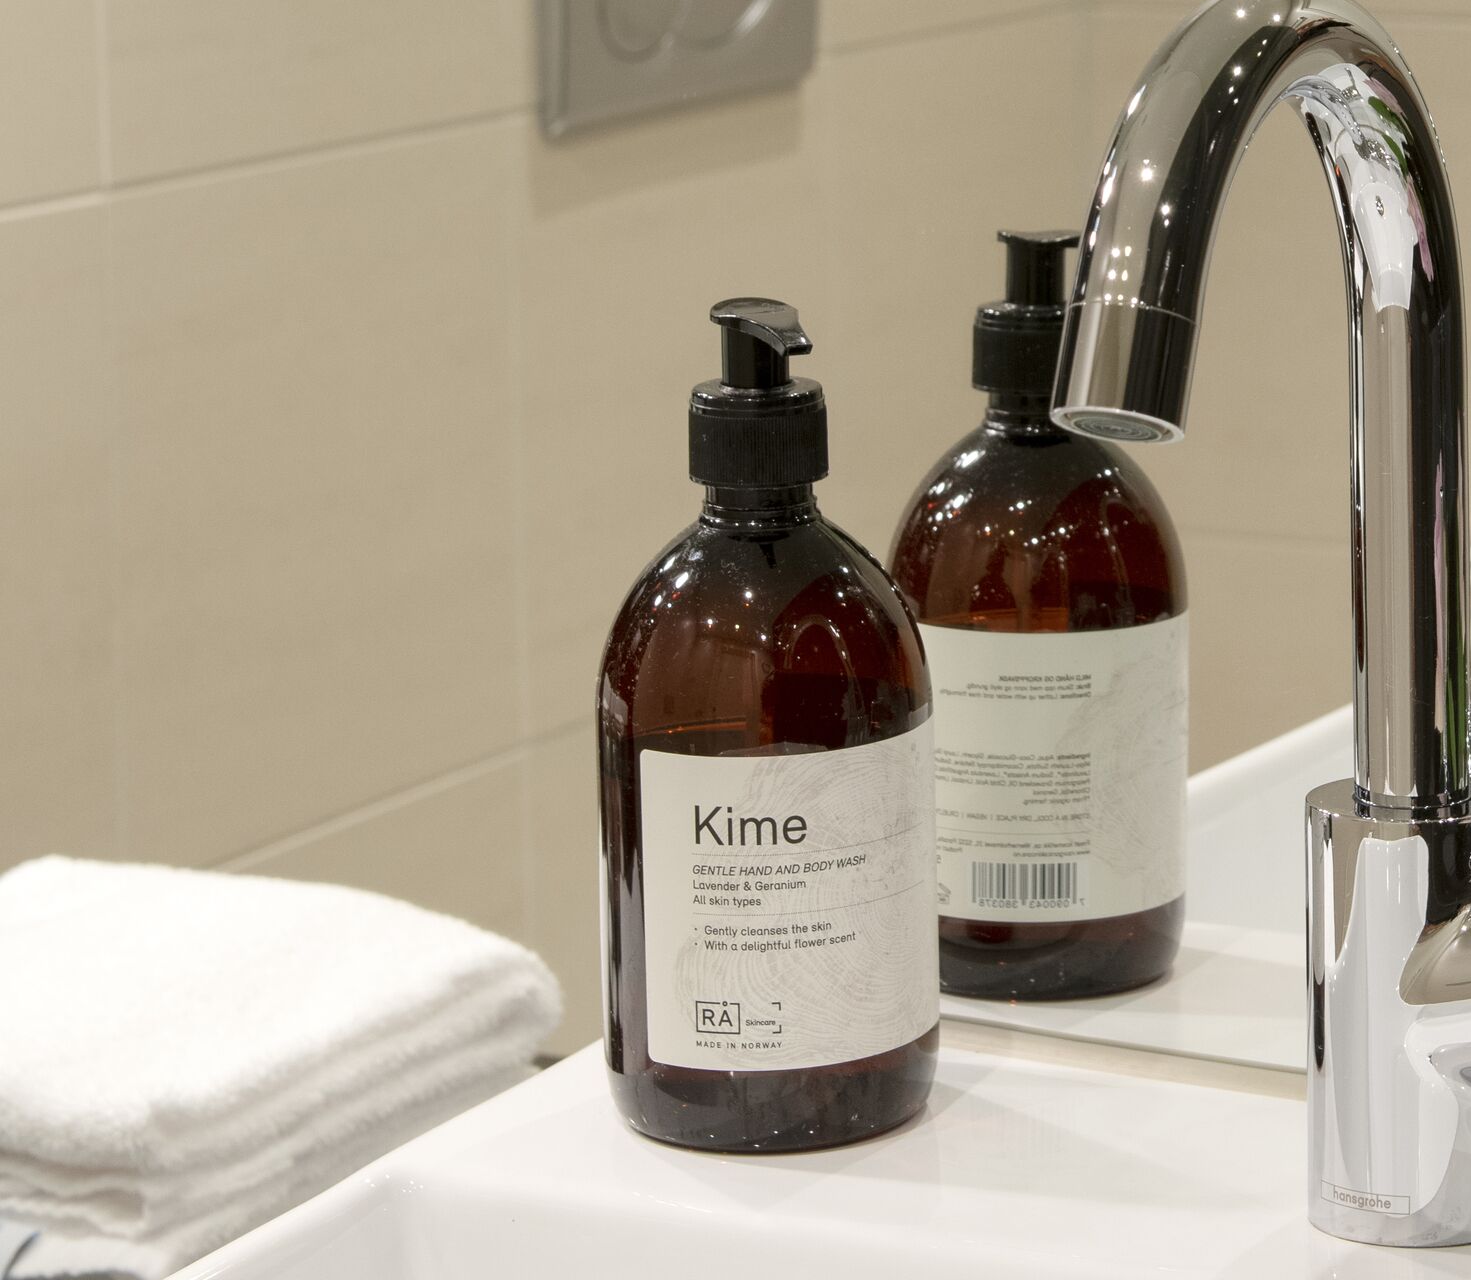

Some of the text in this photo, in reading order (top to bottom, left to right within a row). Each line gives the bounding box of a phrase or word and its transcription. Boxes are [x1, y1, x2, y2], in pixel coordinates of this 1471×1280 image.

[695, 805, 807, 846] Kime
[692, 854, 866, 876] GENTLE HAND AND BODY WASH
[692, 879, 806, 891] Lavender & Geranium
[693, 895, 762, 908] All skin types
[704, 921, 832, 938] Gently cleanses the skin
[704, 931, 856, 953] With a delightful flower scent
[702, 1001, 776, 1027] RÅ Skincare
[696, 1040, 722, 1049] MADE
[741, 1041, 782, 1050] NORWAY
[1333, 1185, 1392, 1209] hansgrohe
